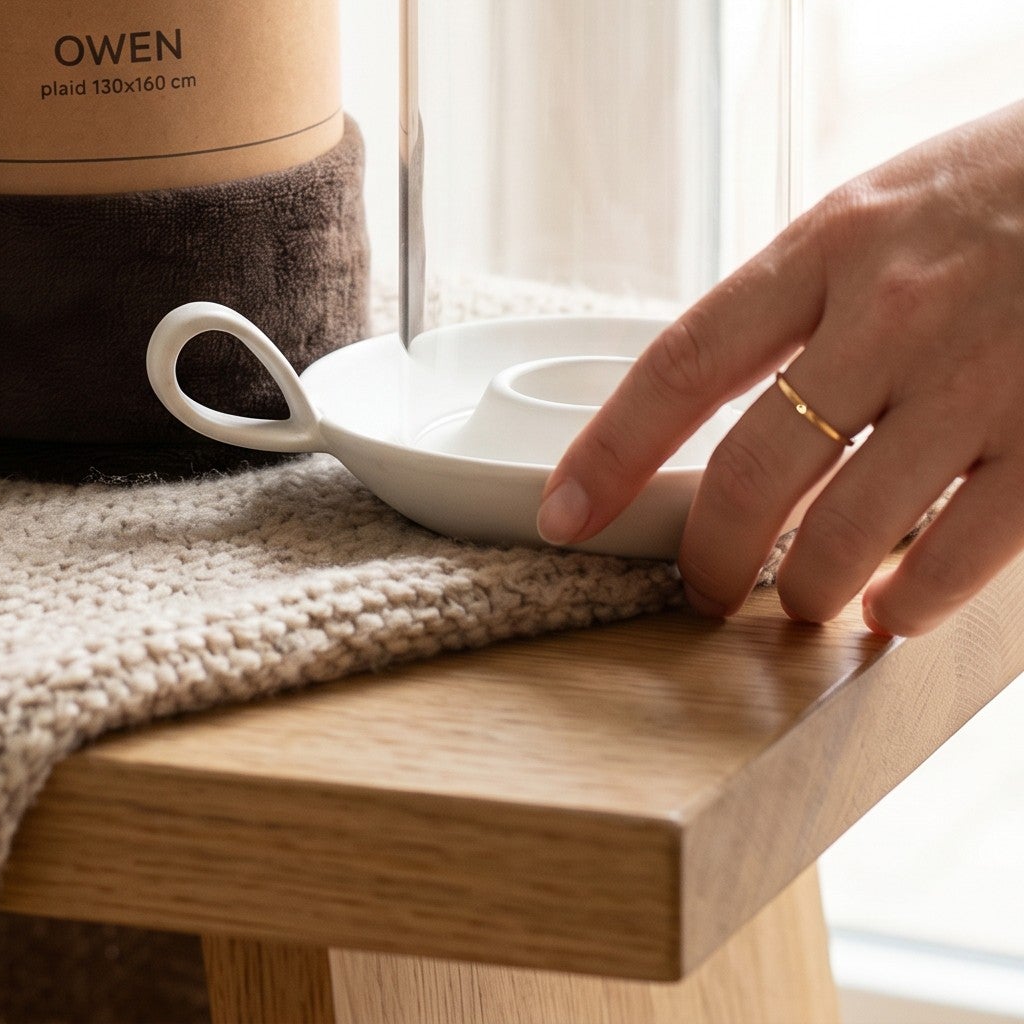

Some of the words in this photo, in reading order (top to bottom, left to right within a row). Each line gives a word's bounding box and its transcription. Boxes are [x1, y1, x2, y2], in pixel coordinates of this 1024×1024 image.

[54, 28, 182, 67] OWEN
[41, 80, 86, 100] plaid
[92, 75, 166, 94] 130x160
[171, 75, 196, 88] cm
